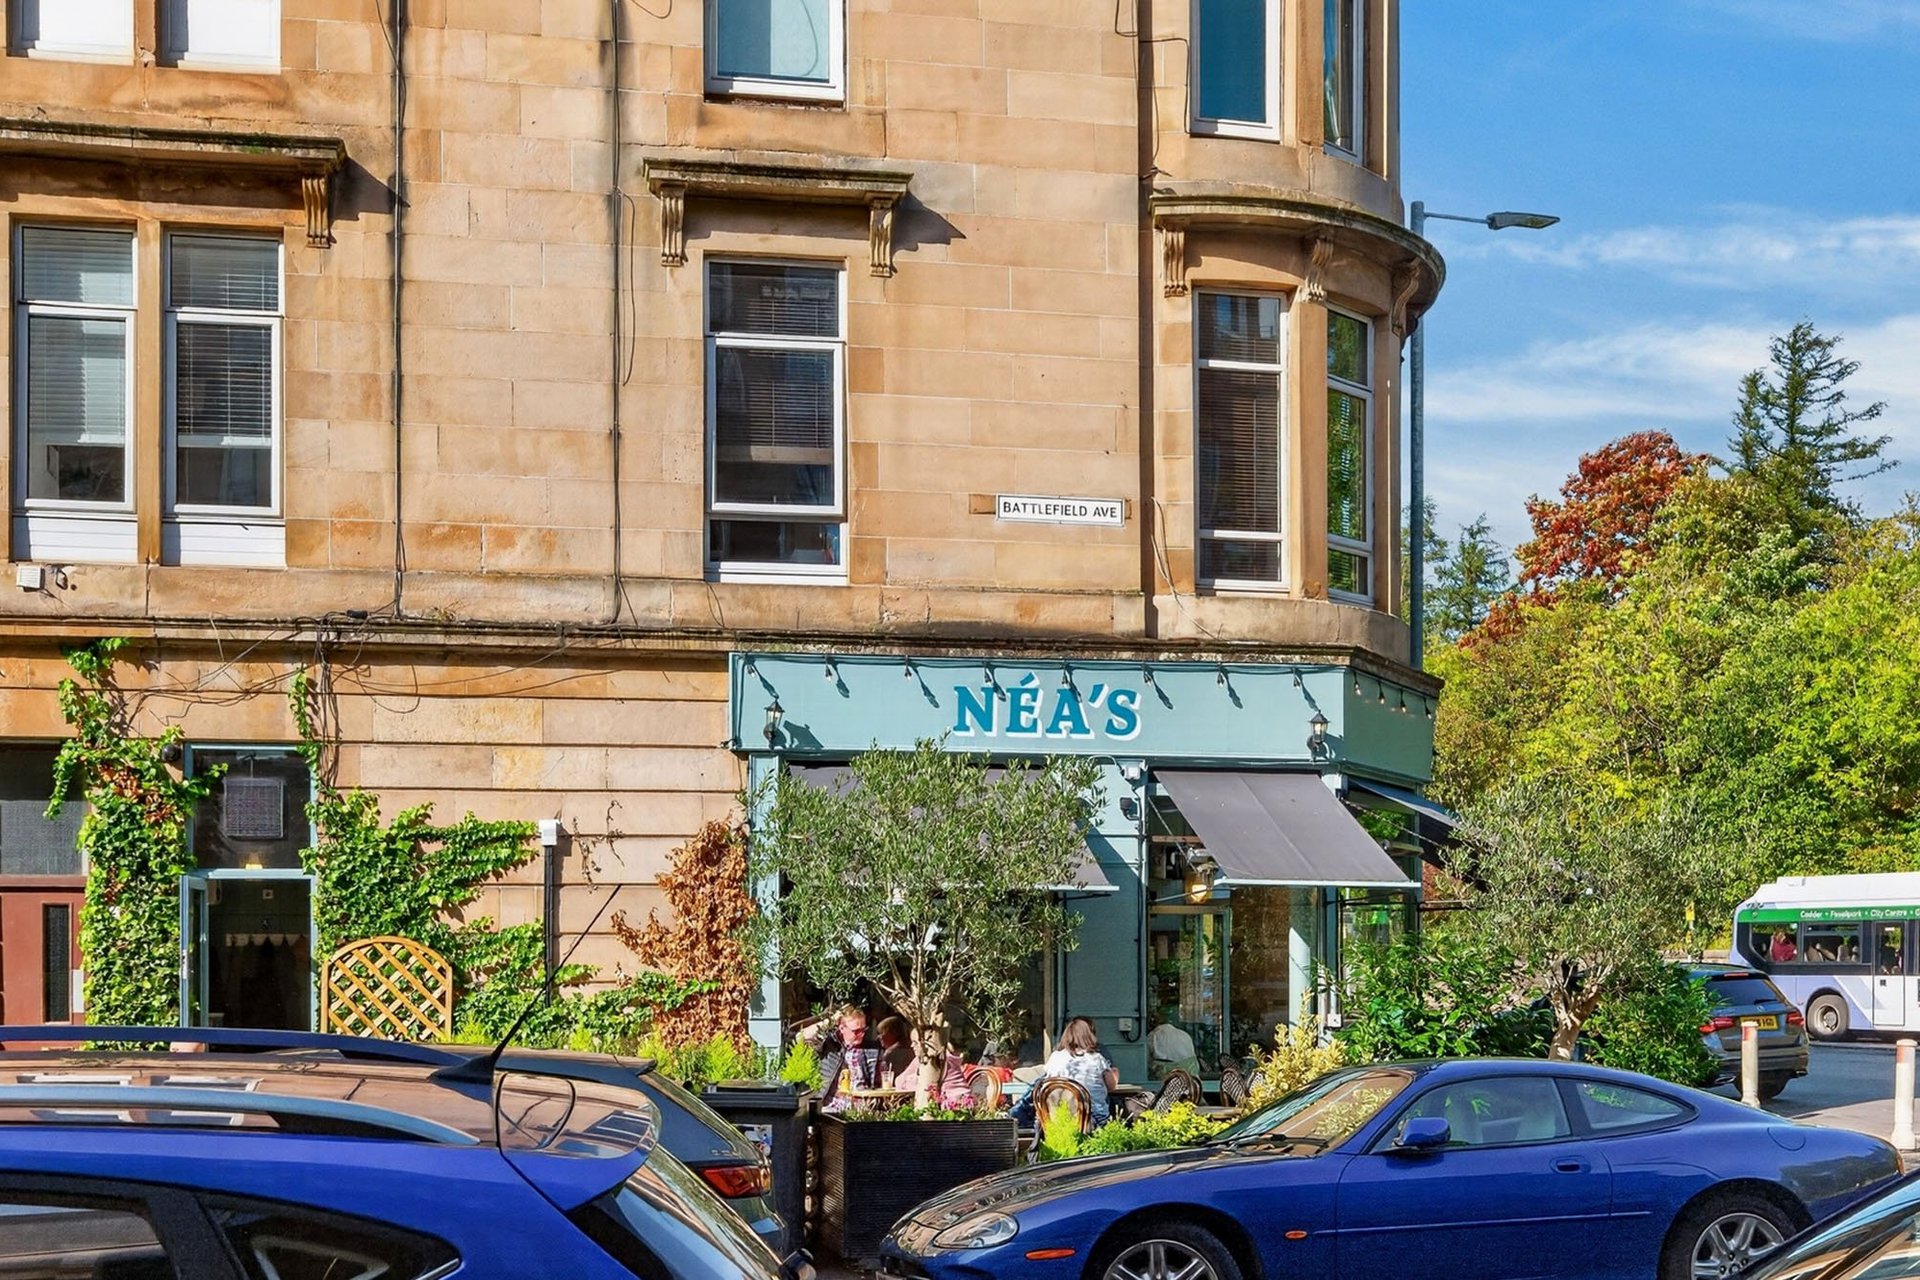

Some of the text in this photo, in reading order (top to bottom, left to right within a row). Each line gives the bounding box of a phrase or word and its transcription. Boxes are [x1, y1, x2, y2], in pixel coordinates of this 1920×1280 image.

[1003, 501, 1117, 518] BATTLEFIELD AVE
[953, 671, 1141, 740] NÉA'S
